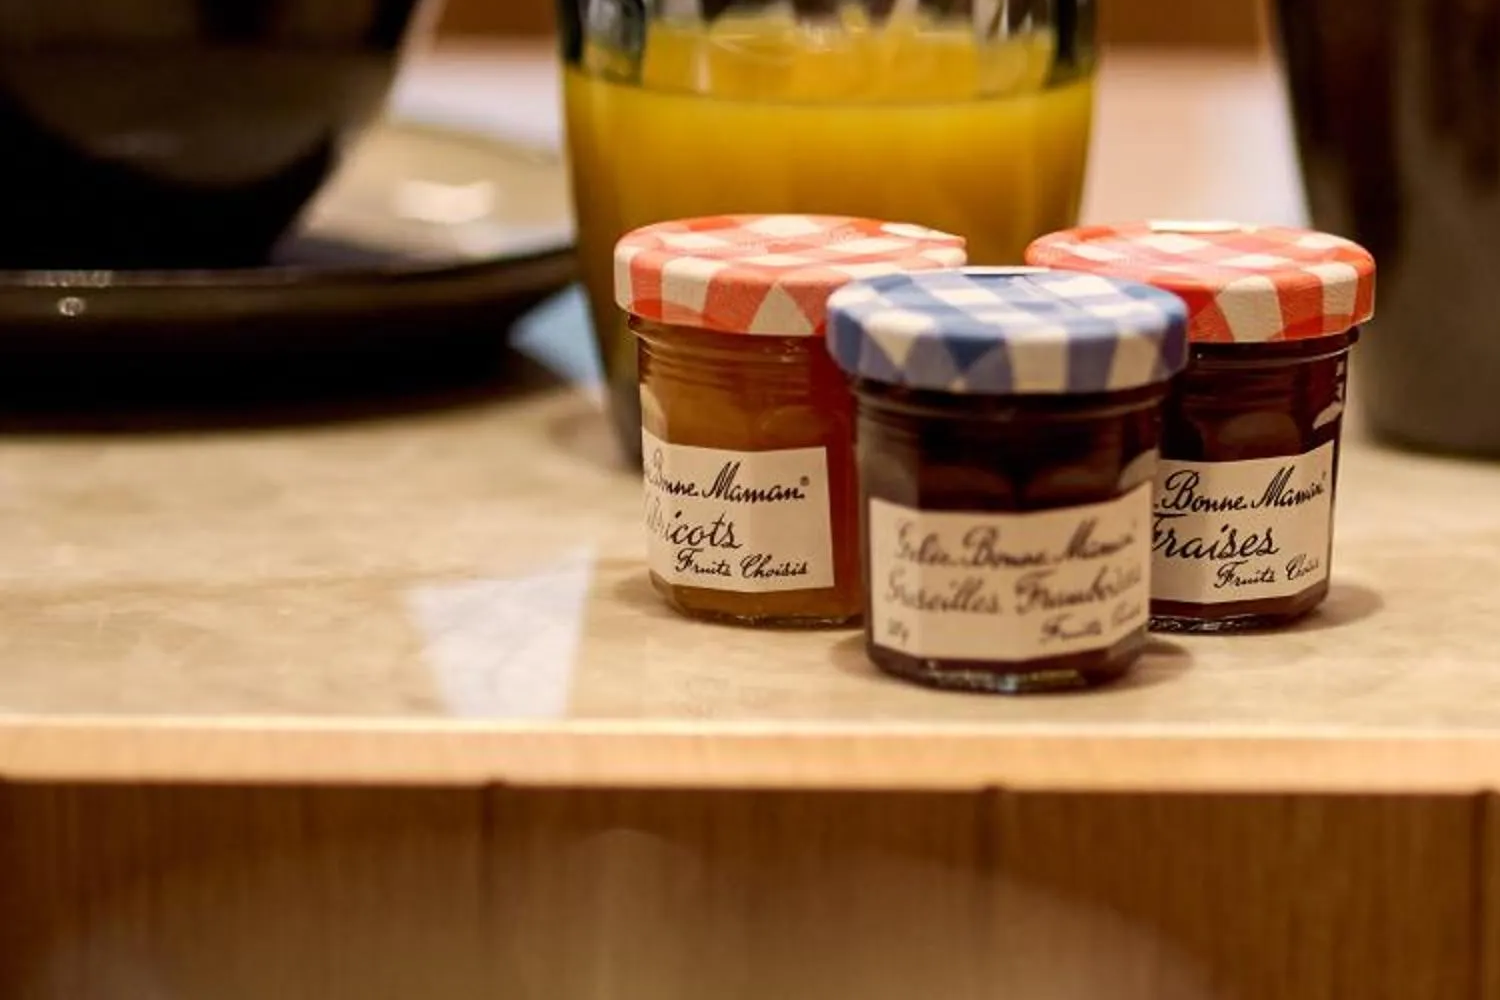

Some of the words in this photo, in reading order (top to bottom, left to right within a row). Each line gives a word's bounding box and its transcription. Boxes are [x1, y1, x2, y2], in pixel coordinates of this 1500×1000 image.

[1162, 469, 1248, 512] Bonne
[1152, 512, 1280, 560] Fraises
[674, 547, 732, 577] Fruits
[739, 553, 808, 578] Choisis
[1213, 560, 1276, 588] Fruits
